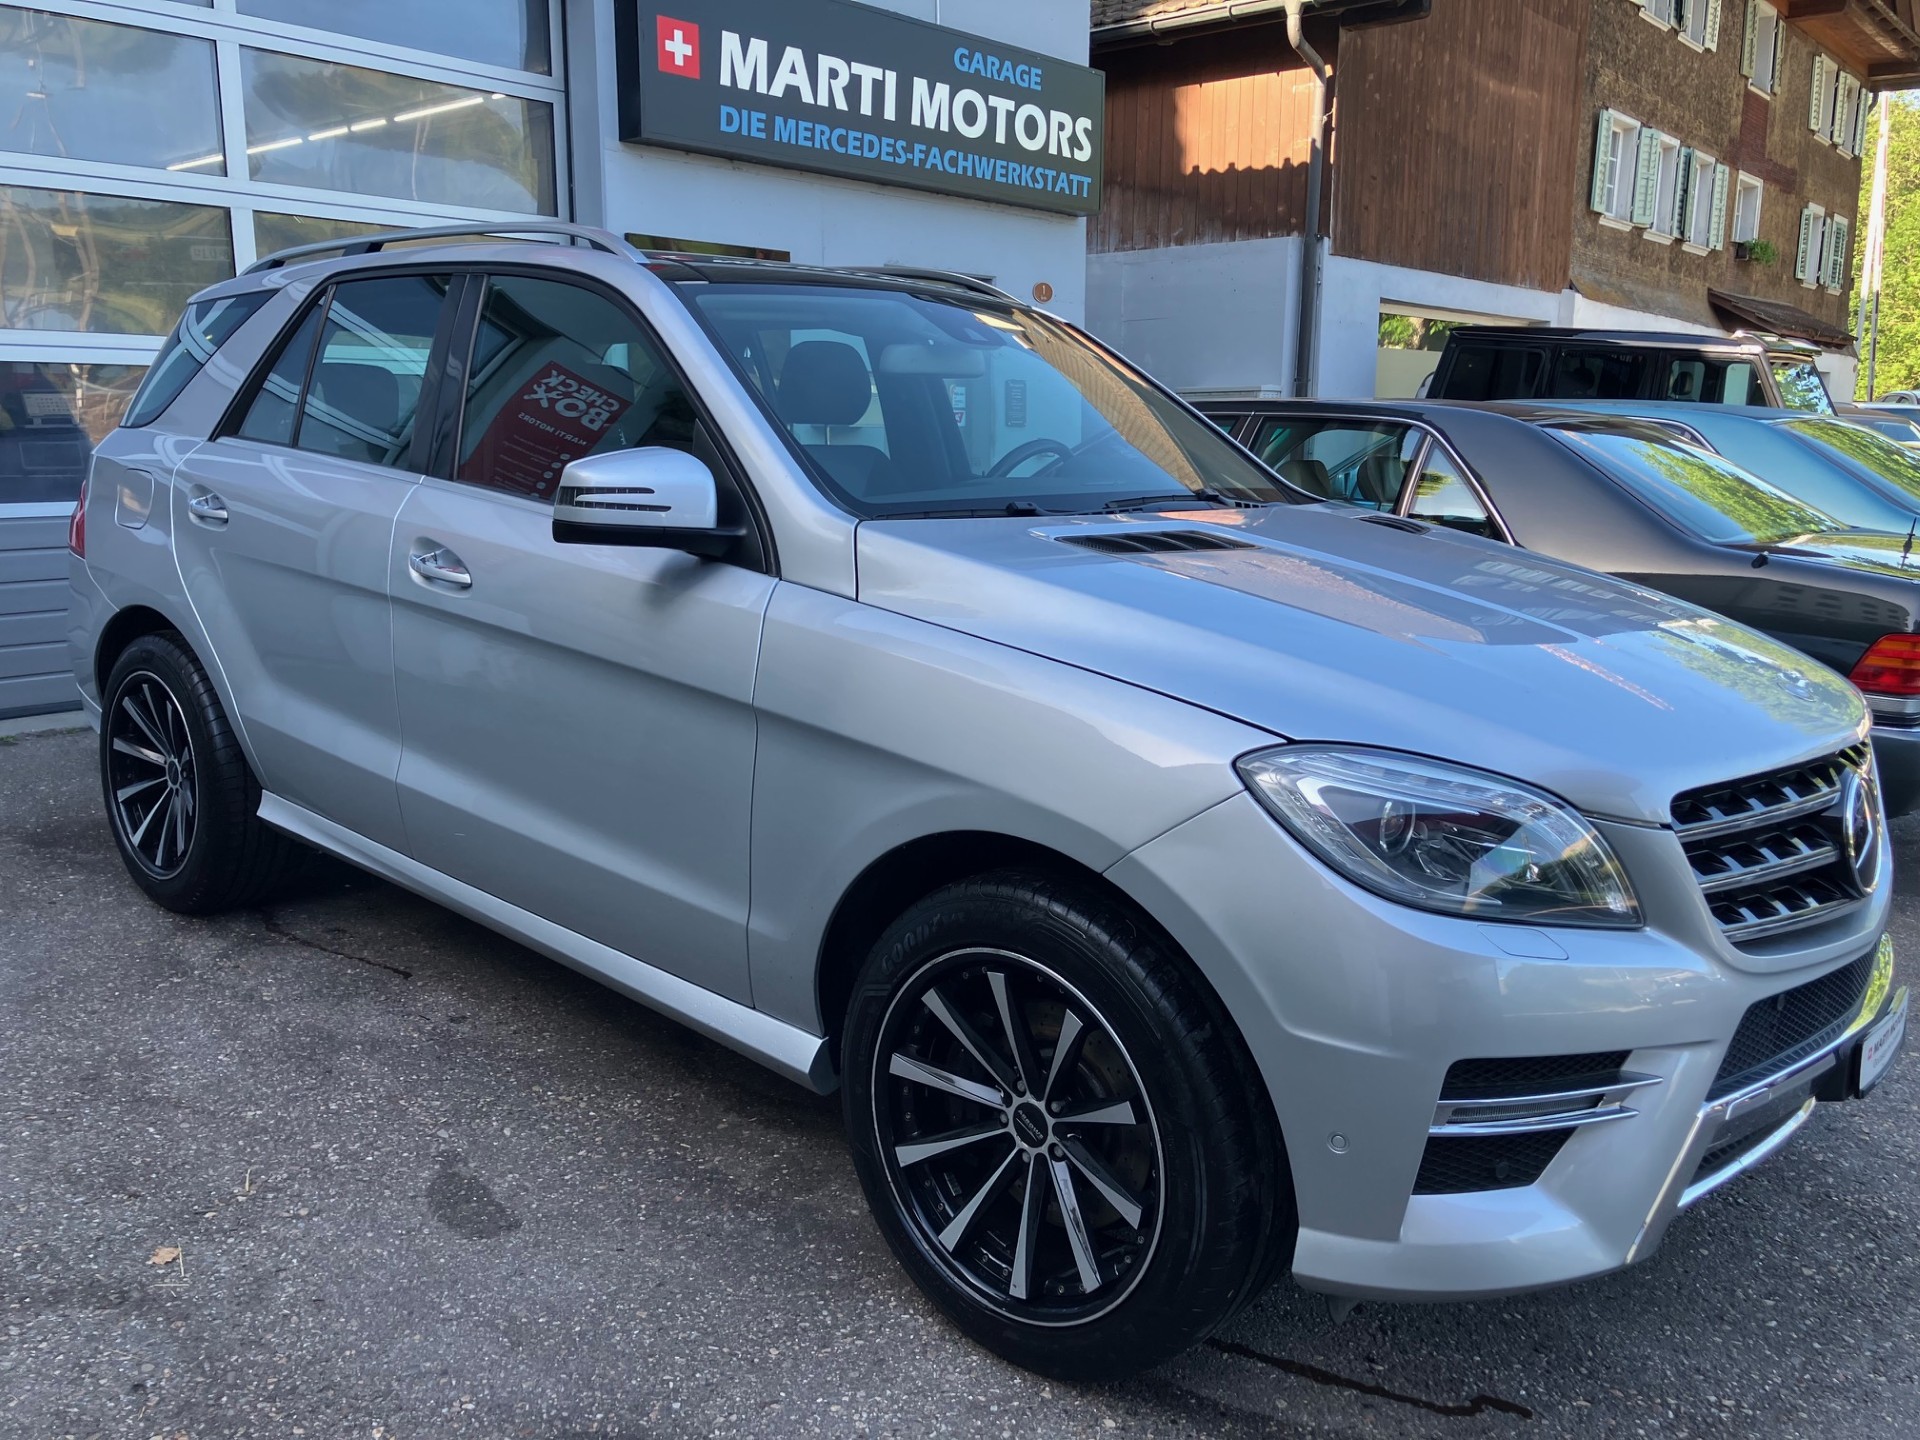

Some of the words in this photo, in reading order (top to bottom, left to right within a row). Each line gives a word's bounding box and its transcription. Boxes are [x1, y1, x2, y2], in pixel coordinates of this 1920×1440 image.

[719, 30, 897, 122] MARTI
[910, 76, 1093, 162] MOTORS
[953, 47, 1043, 92] GARAGE
[719, 104, 767, 140] DIE
[773, 115, 1093, 198] MERCEDES-FACHWERKSTATT
